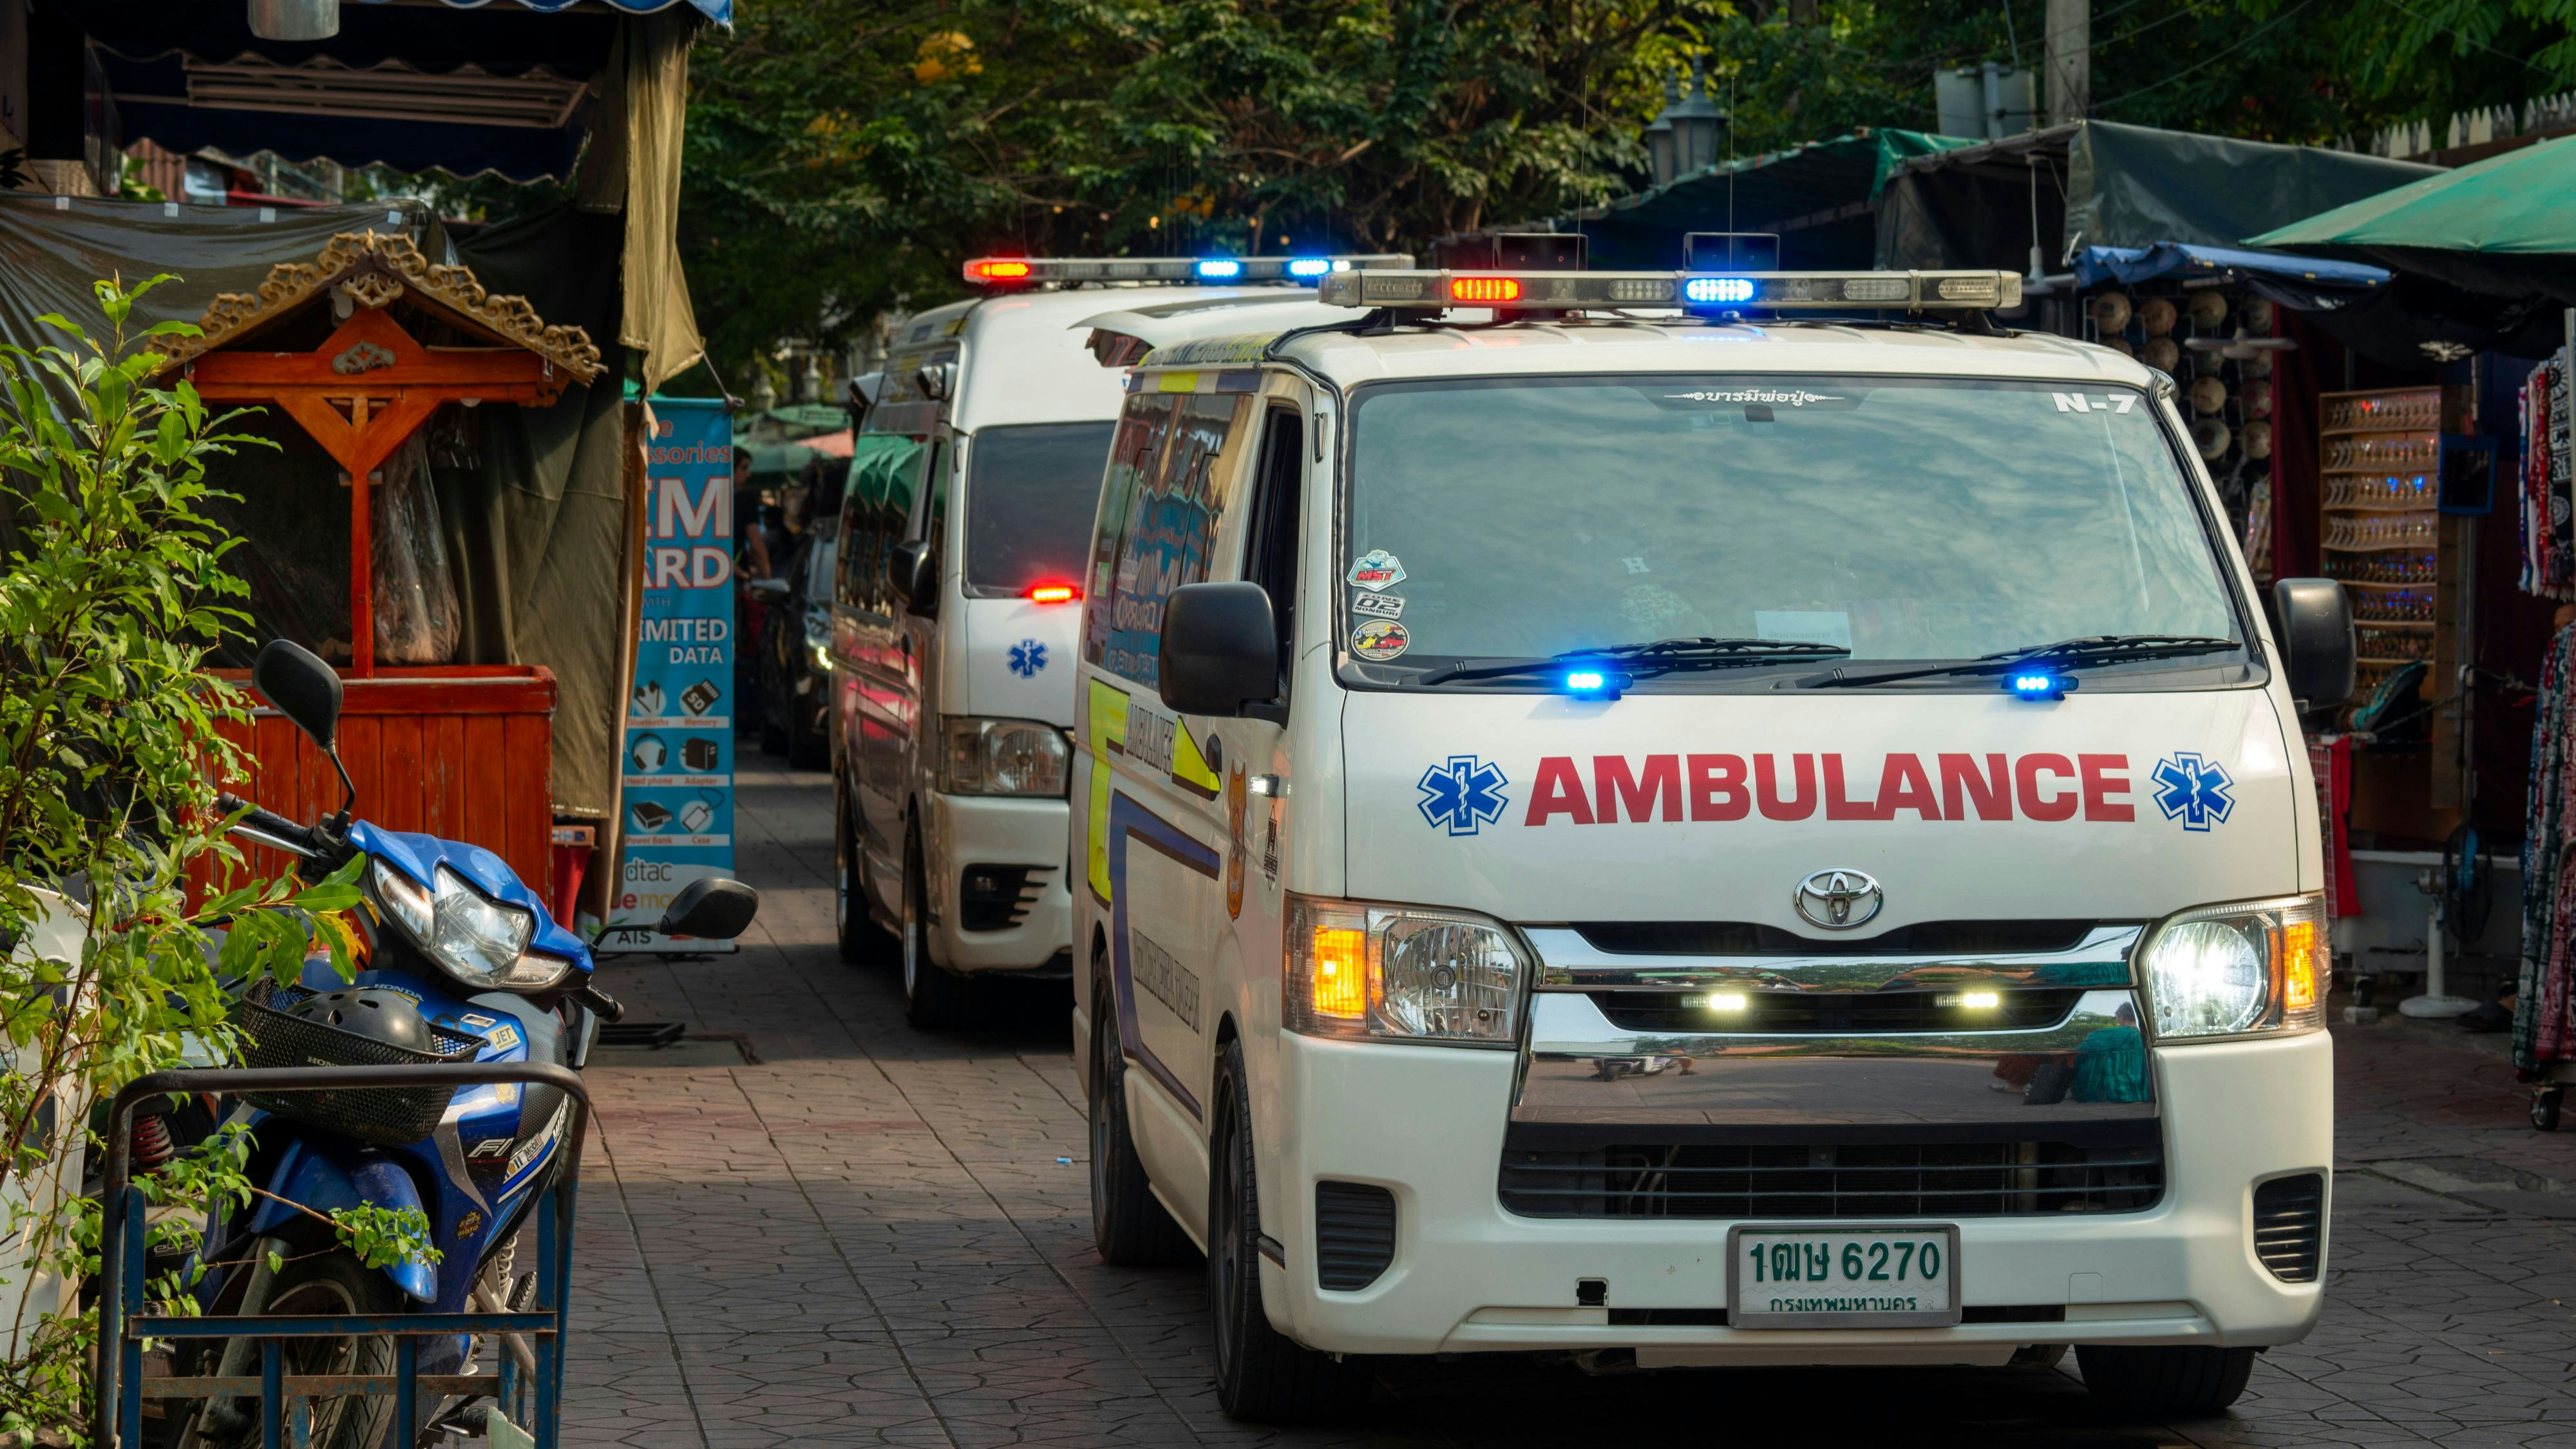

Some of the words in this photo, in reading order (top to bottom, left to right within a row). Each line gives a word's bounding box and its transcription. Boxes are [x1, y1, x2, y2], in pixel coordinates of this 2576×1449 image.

[2052, 393, 2136, 413] N-7
[1356, 598, 1401, 612] 02
[639, 618, 728, 642] IMITED
[669, 647, 723, 665] DATA
[684, 718, 717, 727] Memory
[647, 777, 673, 786] phone
[685, 777, 717, 786] Adapter
[1524, 753, 2134, 826] AMBULANCE
[625, 859, 672, 882] dtac
[374, 983, 424, 1002] HONDA
[495, 1028, 511, 1045] JET
[307, 1056, 341, 1068] HON
[1750, 1242, 1830, 1282] 1ฒษ
[1842, 1241, 1940, 1281] 6270
[1771, 1296, 1917, 1312] กรงเทพมหานคร
